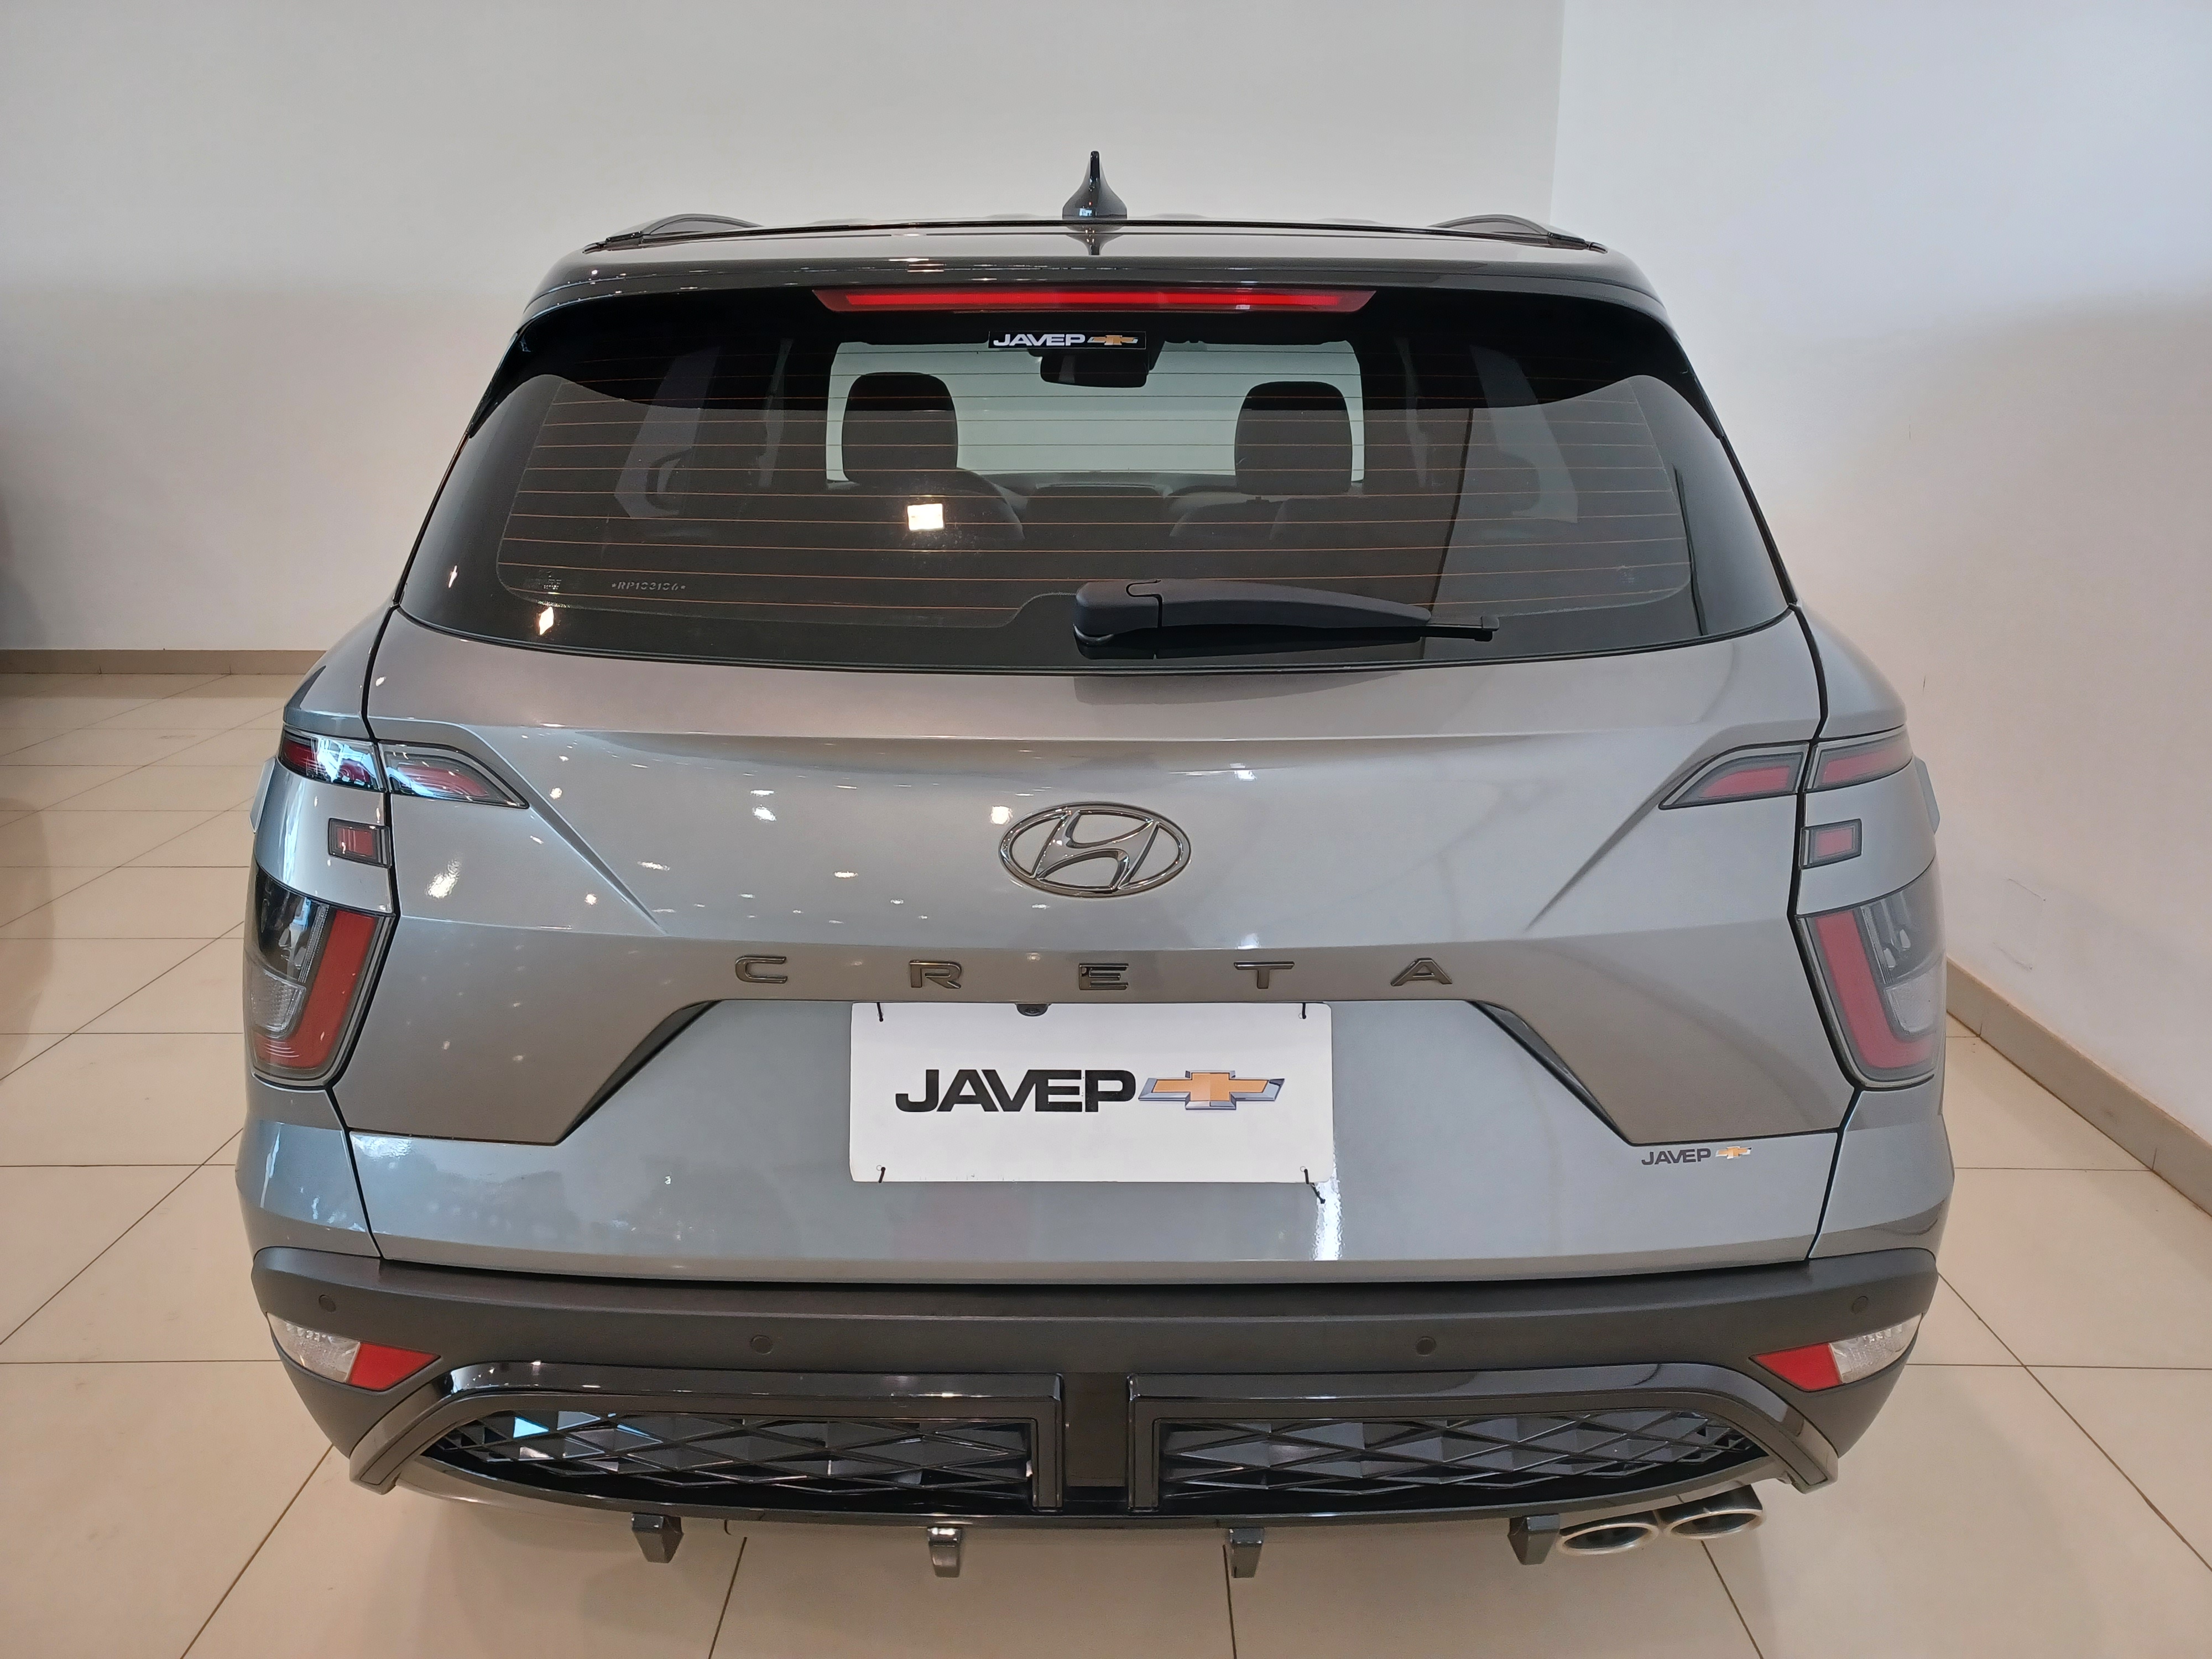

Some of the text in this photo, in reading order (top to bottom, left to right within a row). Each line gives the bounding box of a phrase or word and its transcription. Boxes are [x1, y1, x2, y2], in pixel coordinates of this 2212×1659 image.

[993, 333, 1085, 346] JAVEP
[734, 956, 1453, 990] CRETA
[895, 1068, 1136, 1112] JAVEP
[1641, 1148, 1712, 1165] JAVEP
